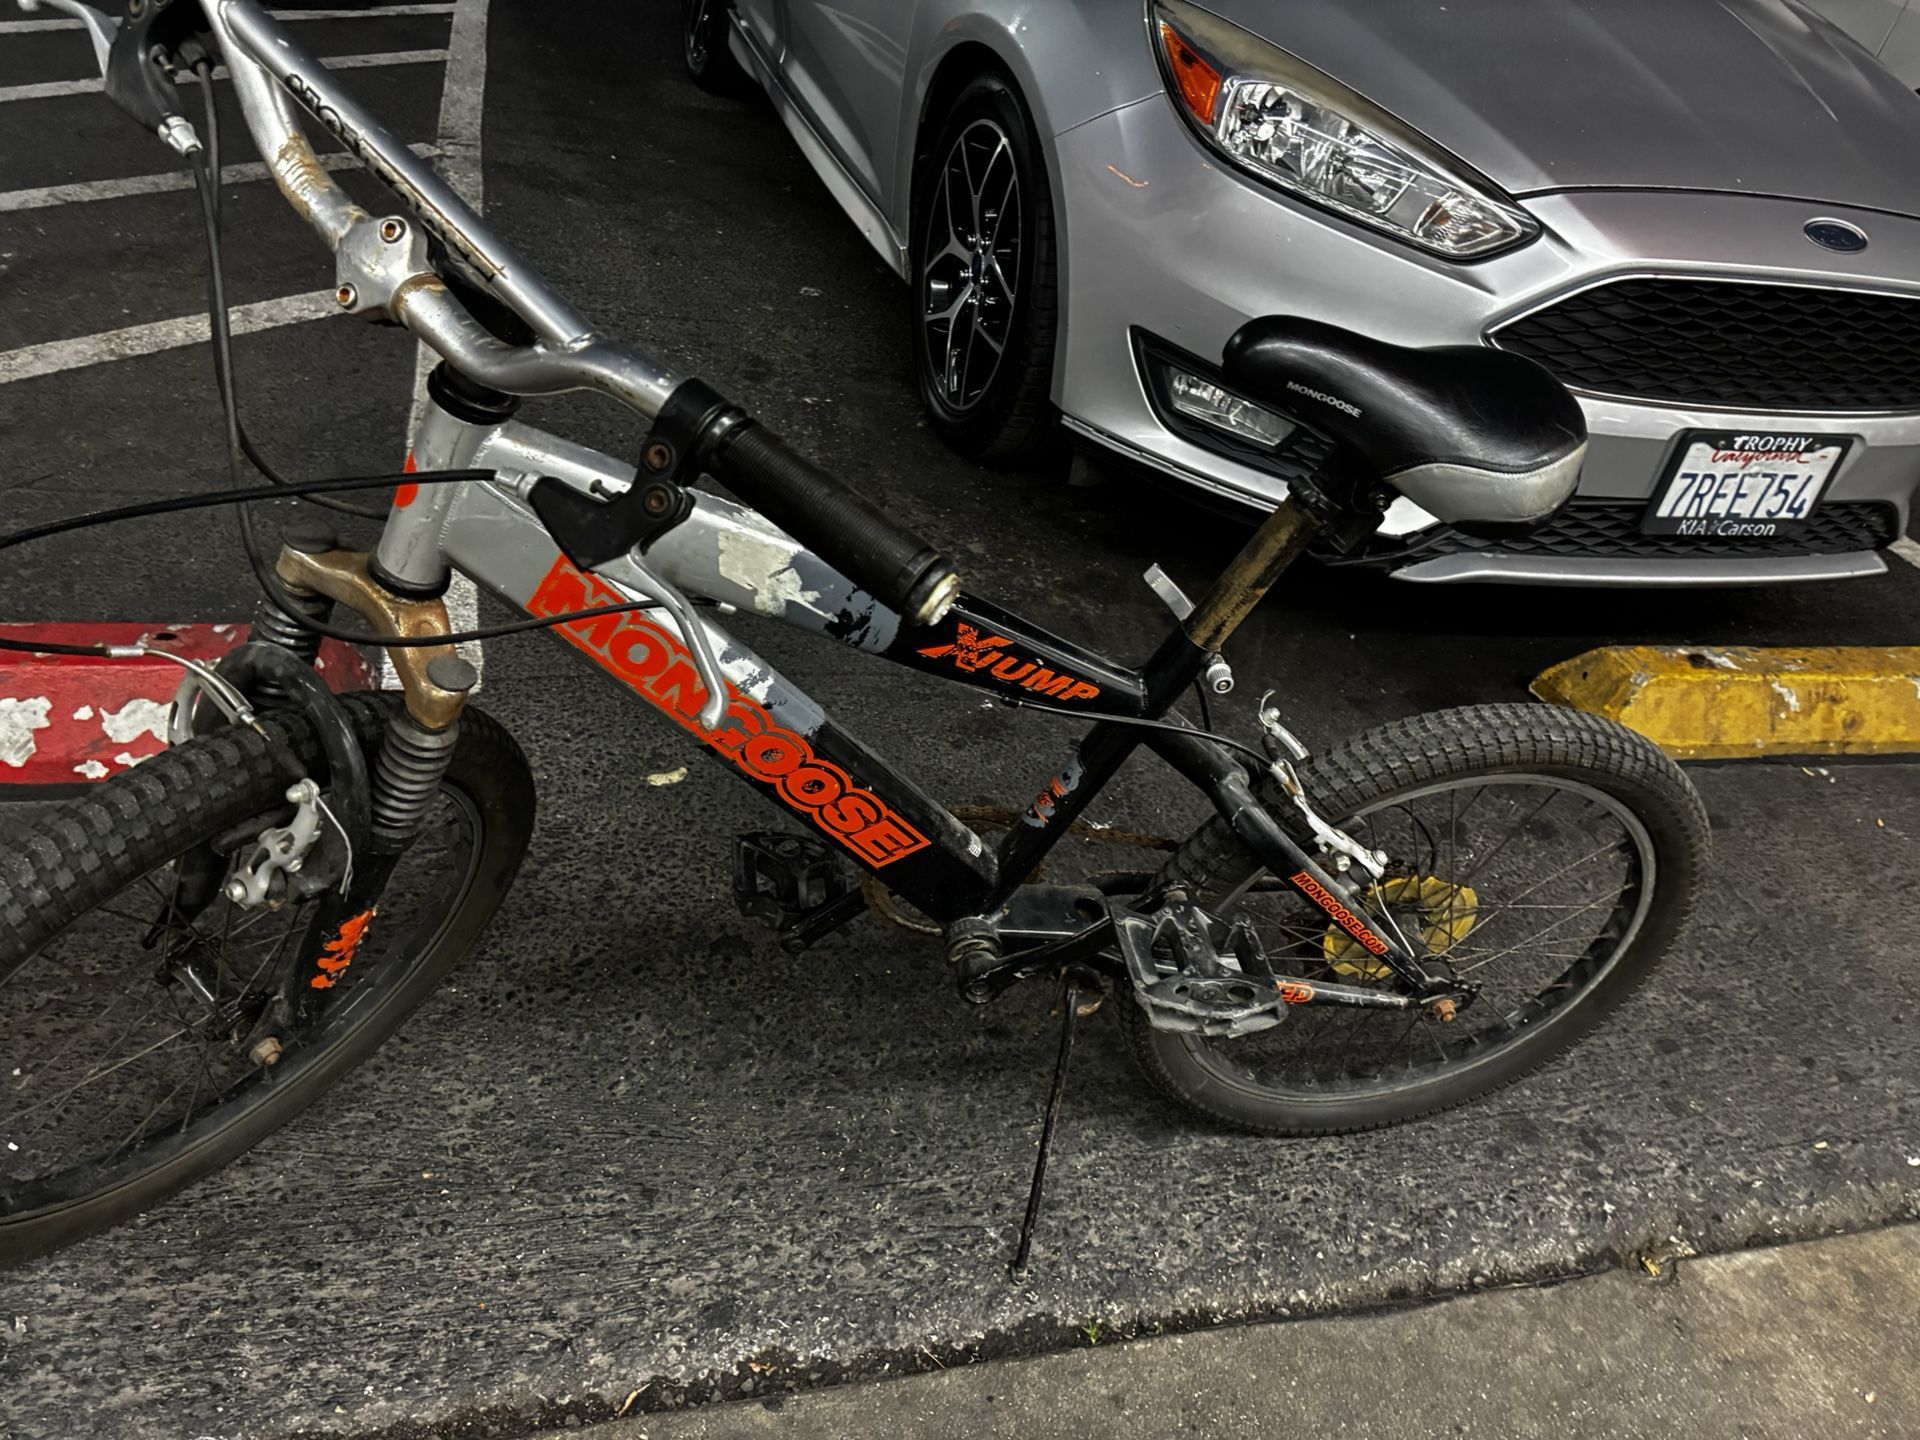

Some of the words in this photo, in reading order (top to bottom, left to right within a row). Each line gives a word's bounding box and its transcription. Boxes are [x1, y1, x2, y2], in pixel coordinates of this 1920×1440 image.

[1286, 381, 1362, 418] MONGOOSE
[1733, 436, 1813, 451] TROPHY
[1669, 473, 1813, 518] 7REE754
[1676, 520, 1708, 536] KIA
[1717, 520, 1776, 536] Carson
[1292, 872, 1388, 953] MONGOOSE.COM
